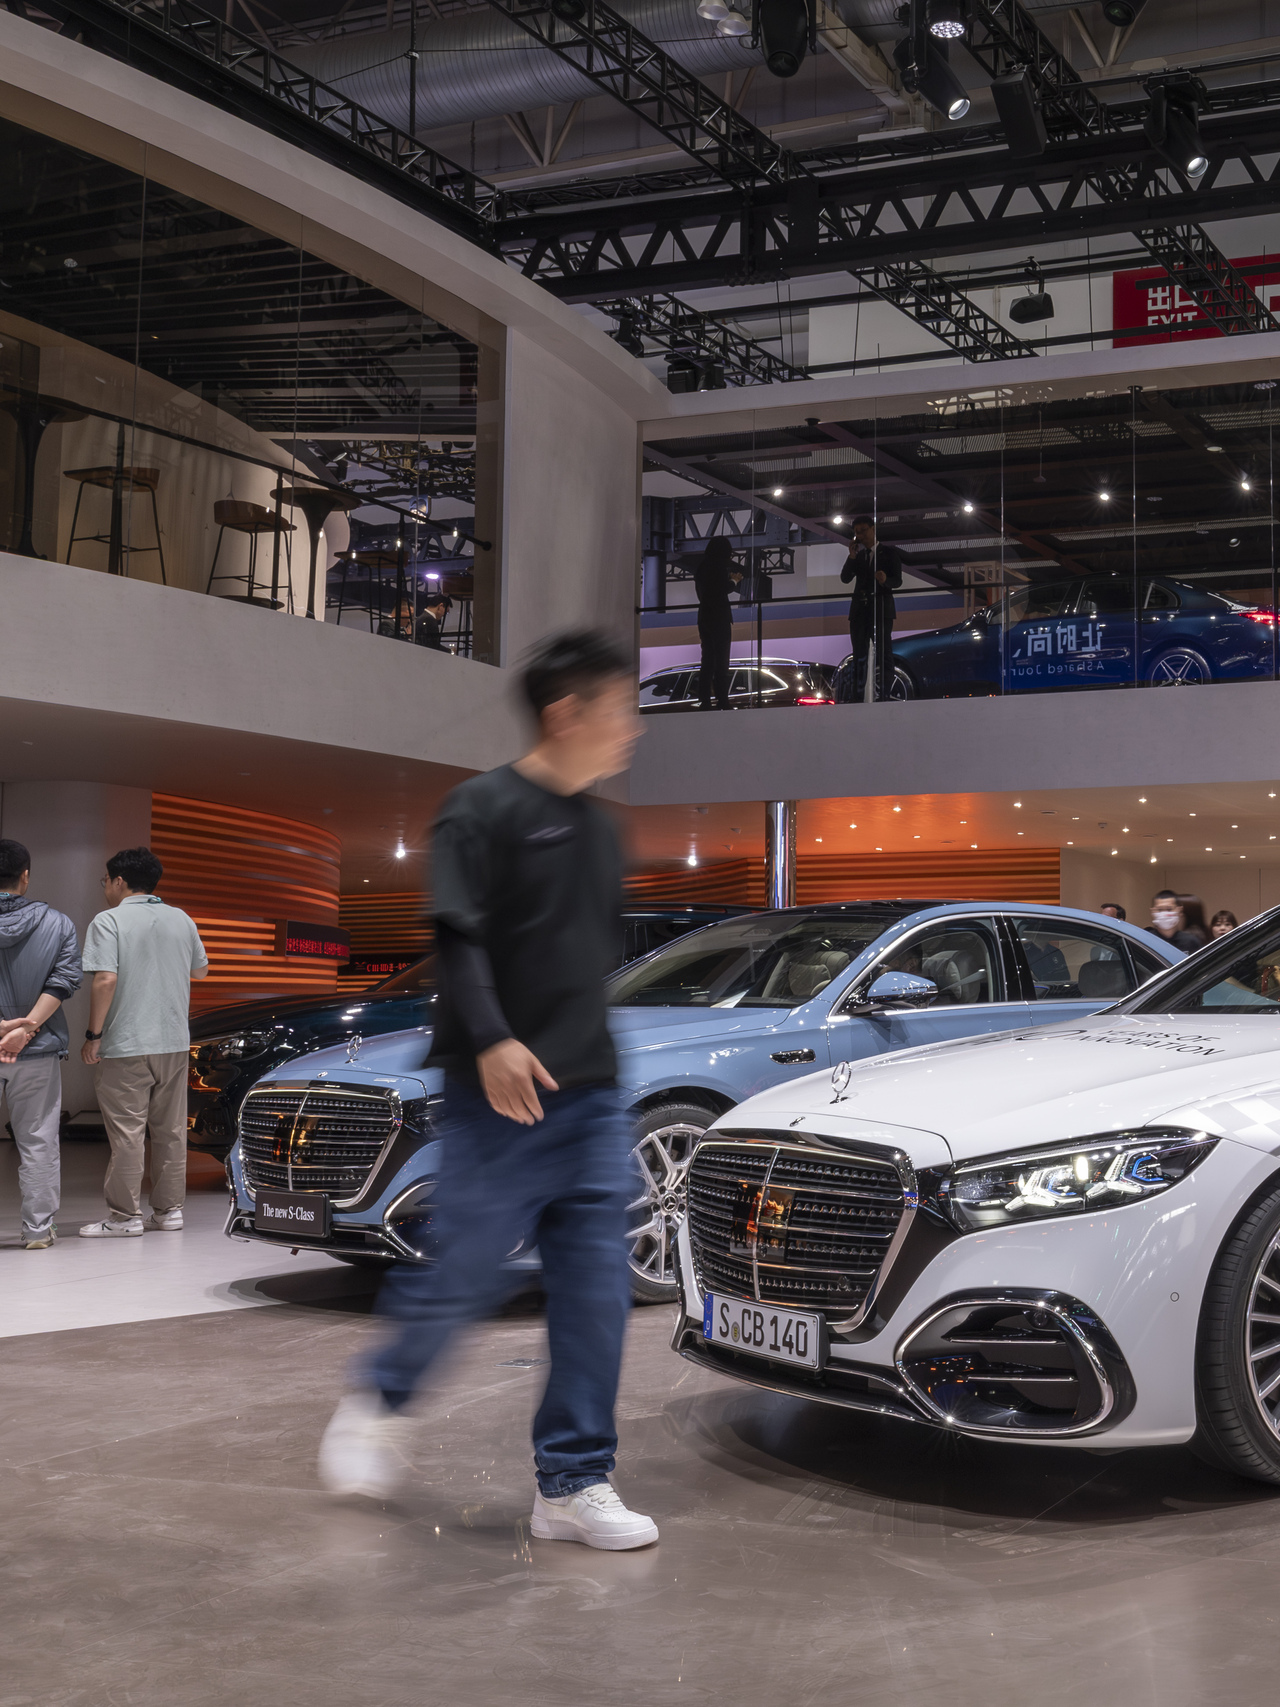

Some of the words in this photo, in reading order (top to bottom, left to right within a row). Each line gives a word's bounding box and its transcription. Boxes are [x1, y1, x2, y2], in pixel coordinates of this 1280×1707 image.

[1147, 284, 1198, 311] 出口
[263, 1203, 274, 1217] The
[275, 1207, 288, 1219] new
[288, 1205, 315, 1222] S-Class
[769, 1315, 808, 1358] 140
